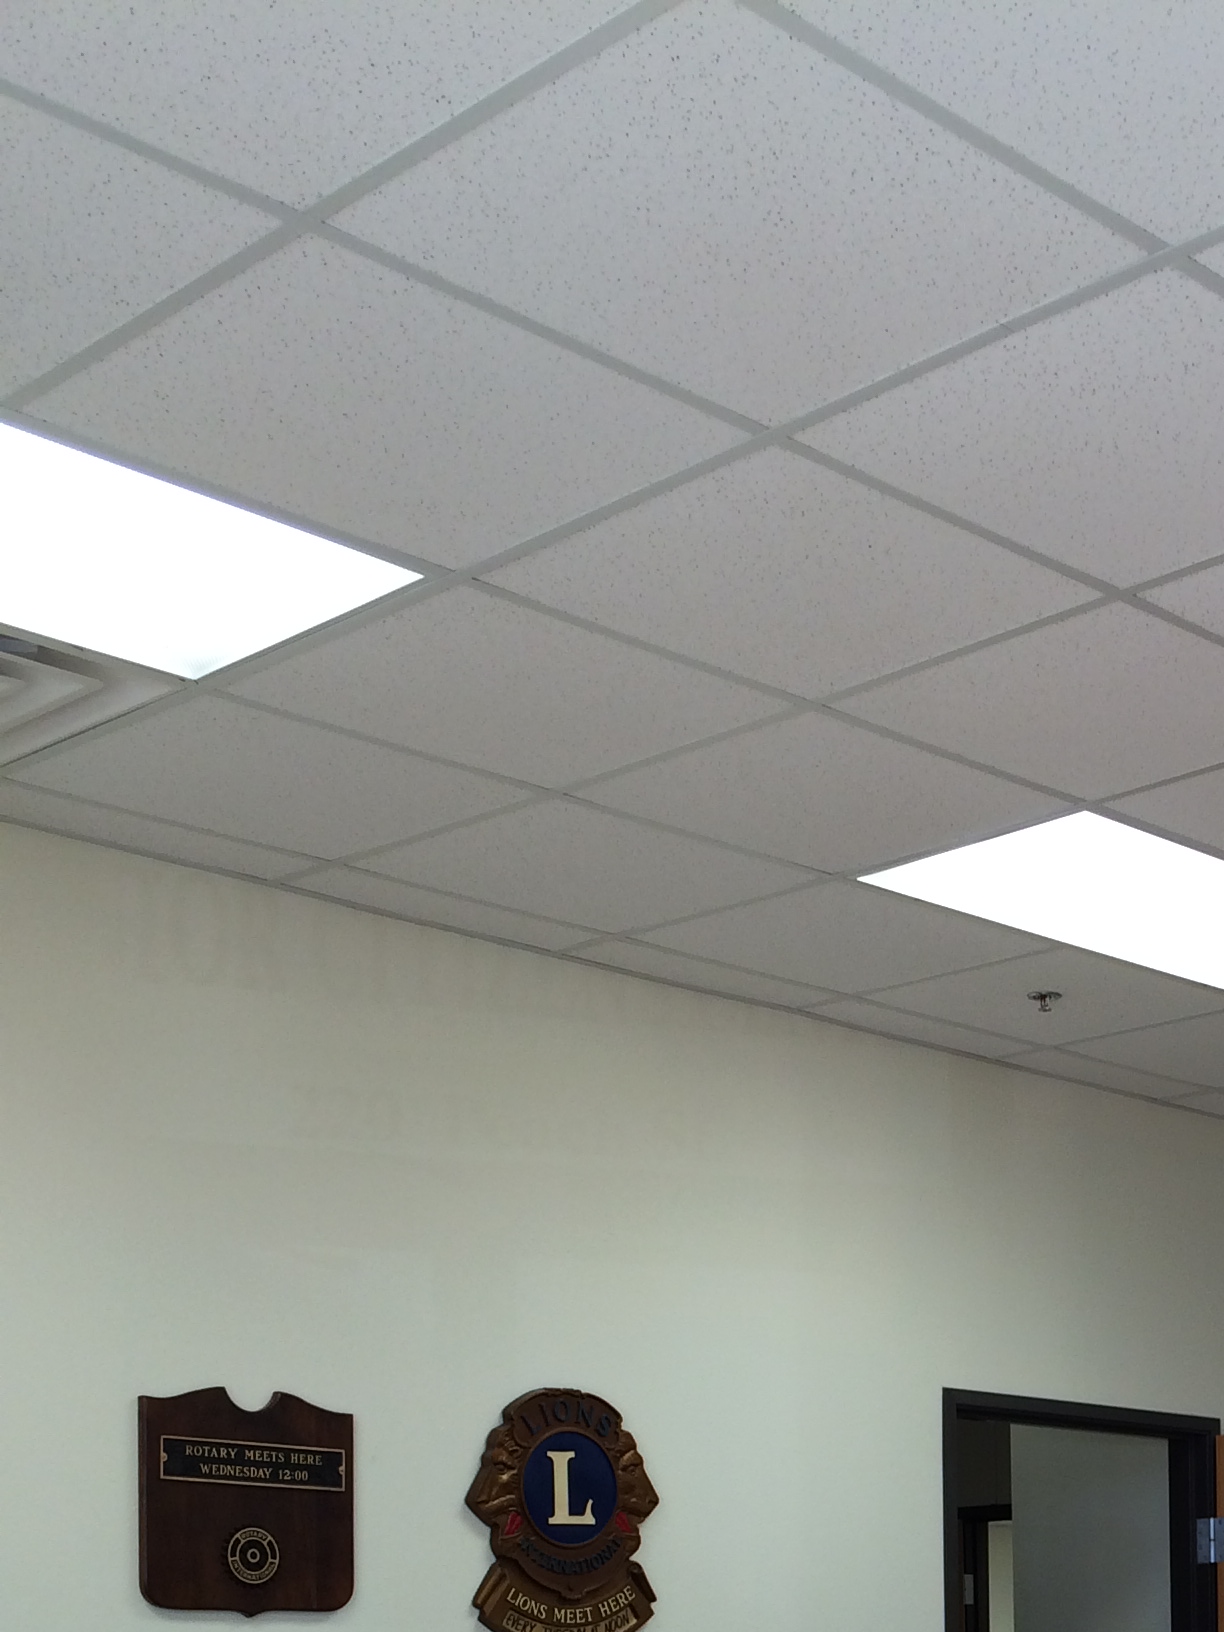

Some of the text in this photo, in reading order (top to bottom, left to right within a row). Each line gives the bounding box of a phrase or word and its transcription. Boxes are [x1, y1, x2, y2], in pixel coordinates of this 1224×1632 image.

[520, 1400, 613, 1437] LIONS
[185, 1444, 323, 1466] ROTARY MEETS HERE
[199, 1463, 309, 1481] WEDNESDAY 12:00
[547, 1450, 596, 1525] L
[506, 1585, 636, 1624] LIONS MEET HERE
